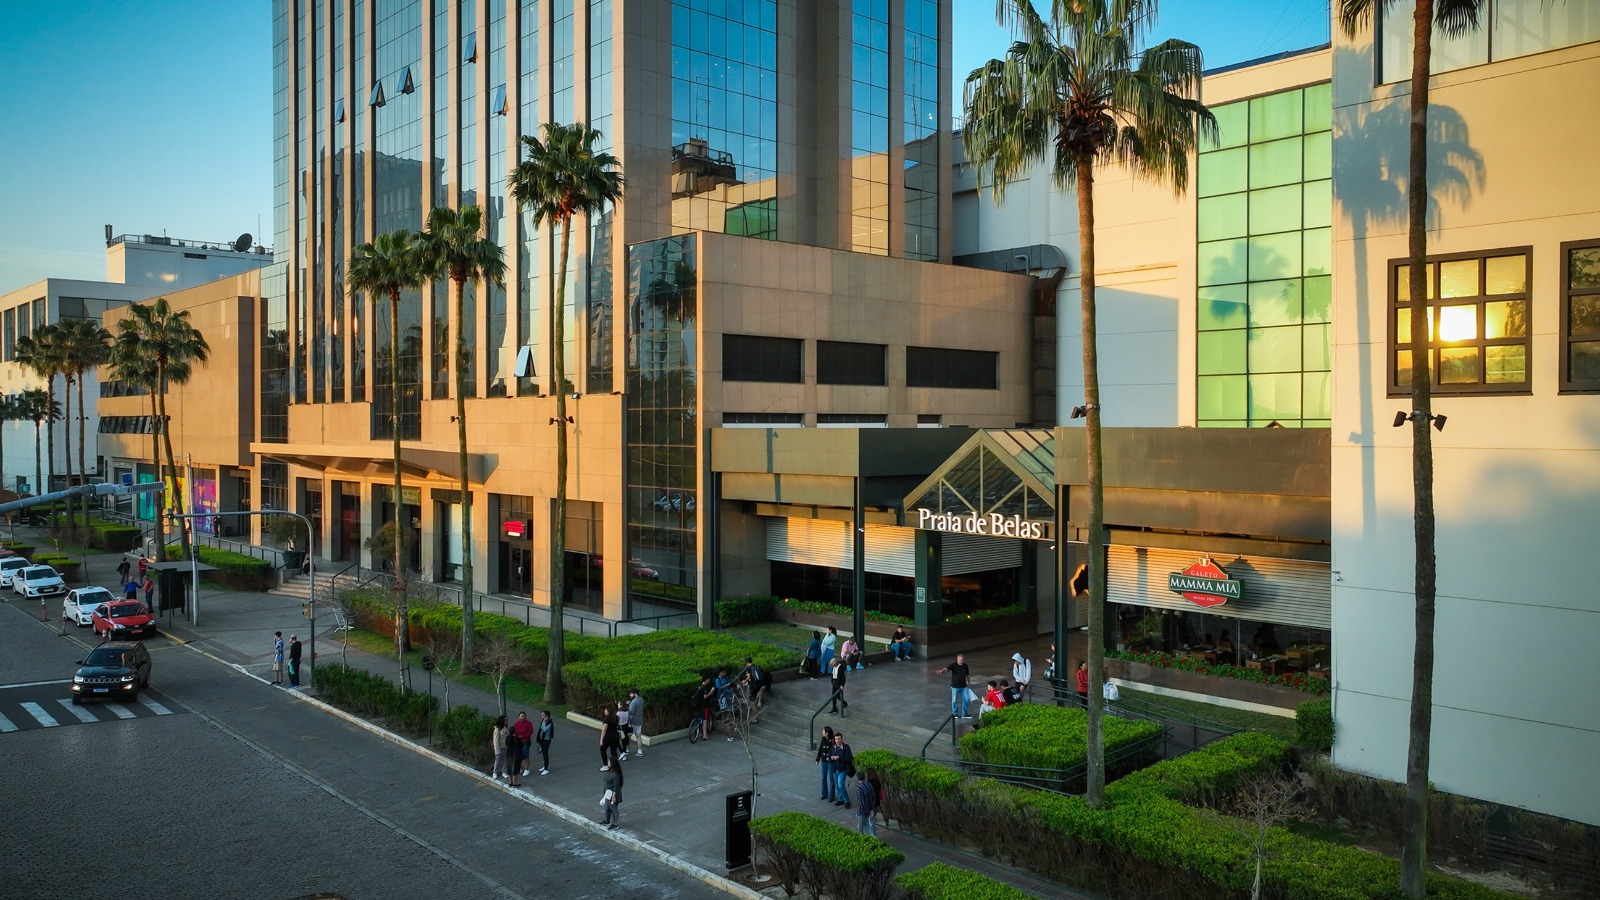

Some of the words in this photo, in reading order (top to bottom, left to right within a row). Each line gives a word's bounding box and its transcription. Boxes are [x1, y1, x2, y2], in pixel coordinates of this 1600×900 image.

[917, 508, 961, 532] Praia
[965, 511, 988, 535] de
[990, 512, 1041, 539] Belas
[1170, 578, 1213, 591] MAMMA
[1216, 582, 1237, 593] MIA
